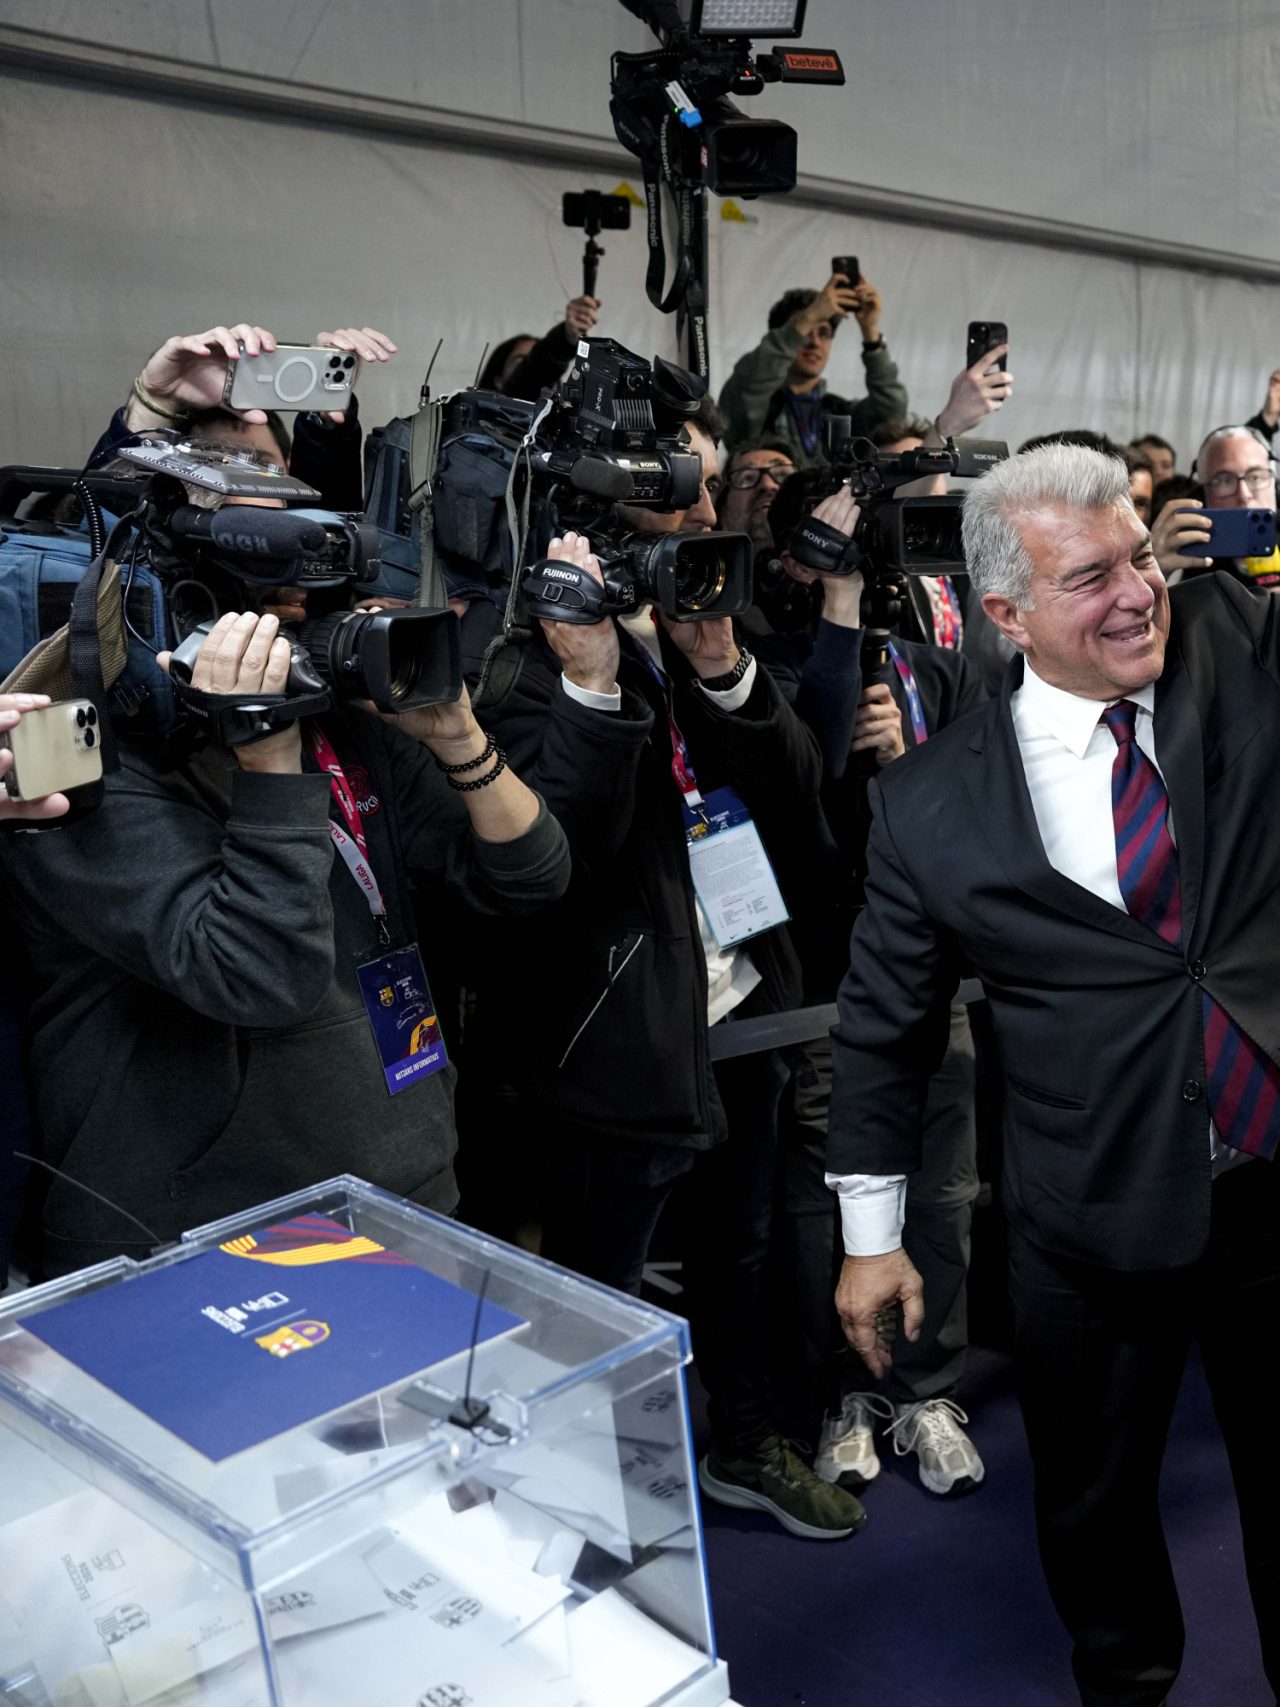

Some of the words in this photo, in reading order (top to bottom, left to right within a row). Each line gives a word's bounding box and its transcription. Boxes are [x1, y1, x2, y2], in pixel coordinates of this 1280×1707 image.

[788, 56, 833, 69] betevé
[647, 183, 659, 248] Panasonic
[694, 315, 707, 377] Panasonic
[639, 461, 660, 469] SONY
[802, 529, 829, 548] SONY
[542, 567, 580, 583] FUJINON
[355, 863, 373, 891] LALIGA
[60, 1553, 91, 1602] ELECCIONS
